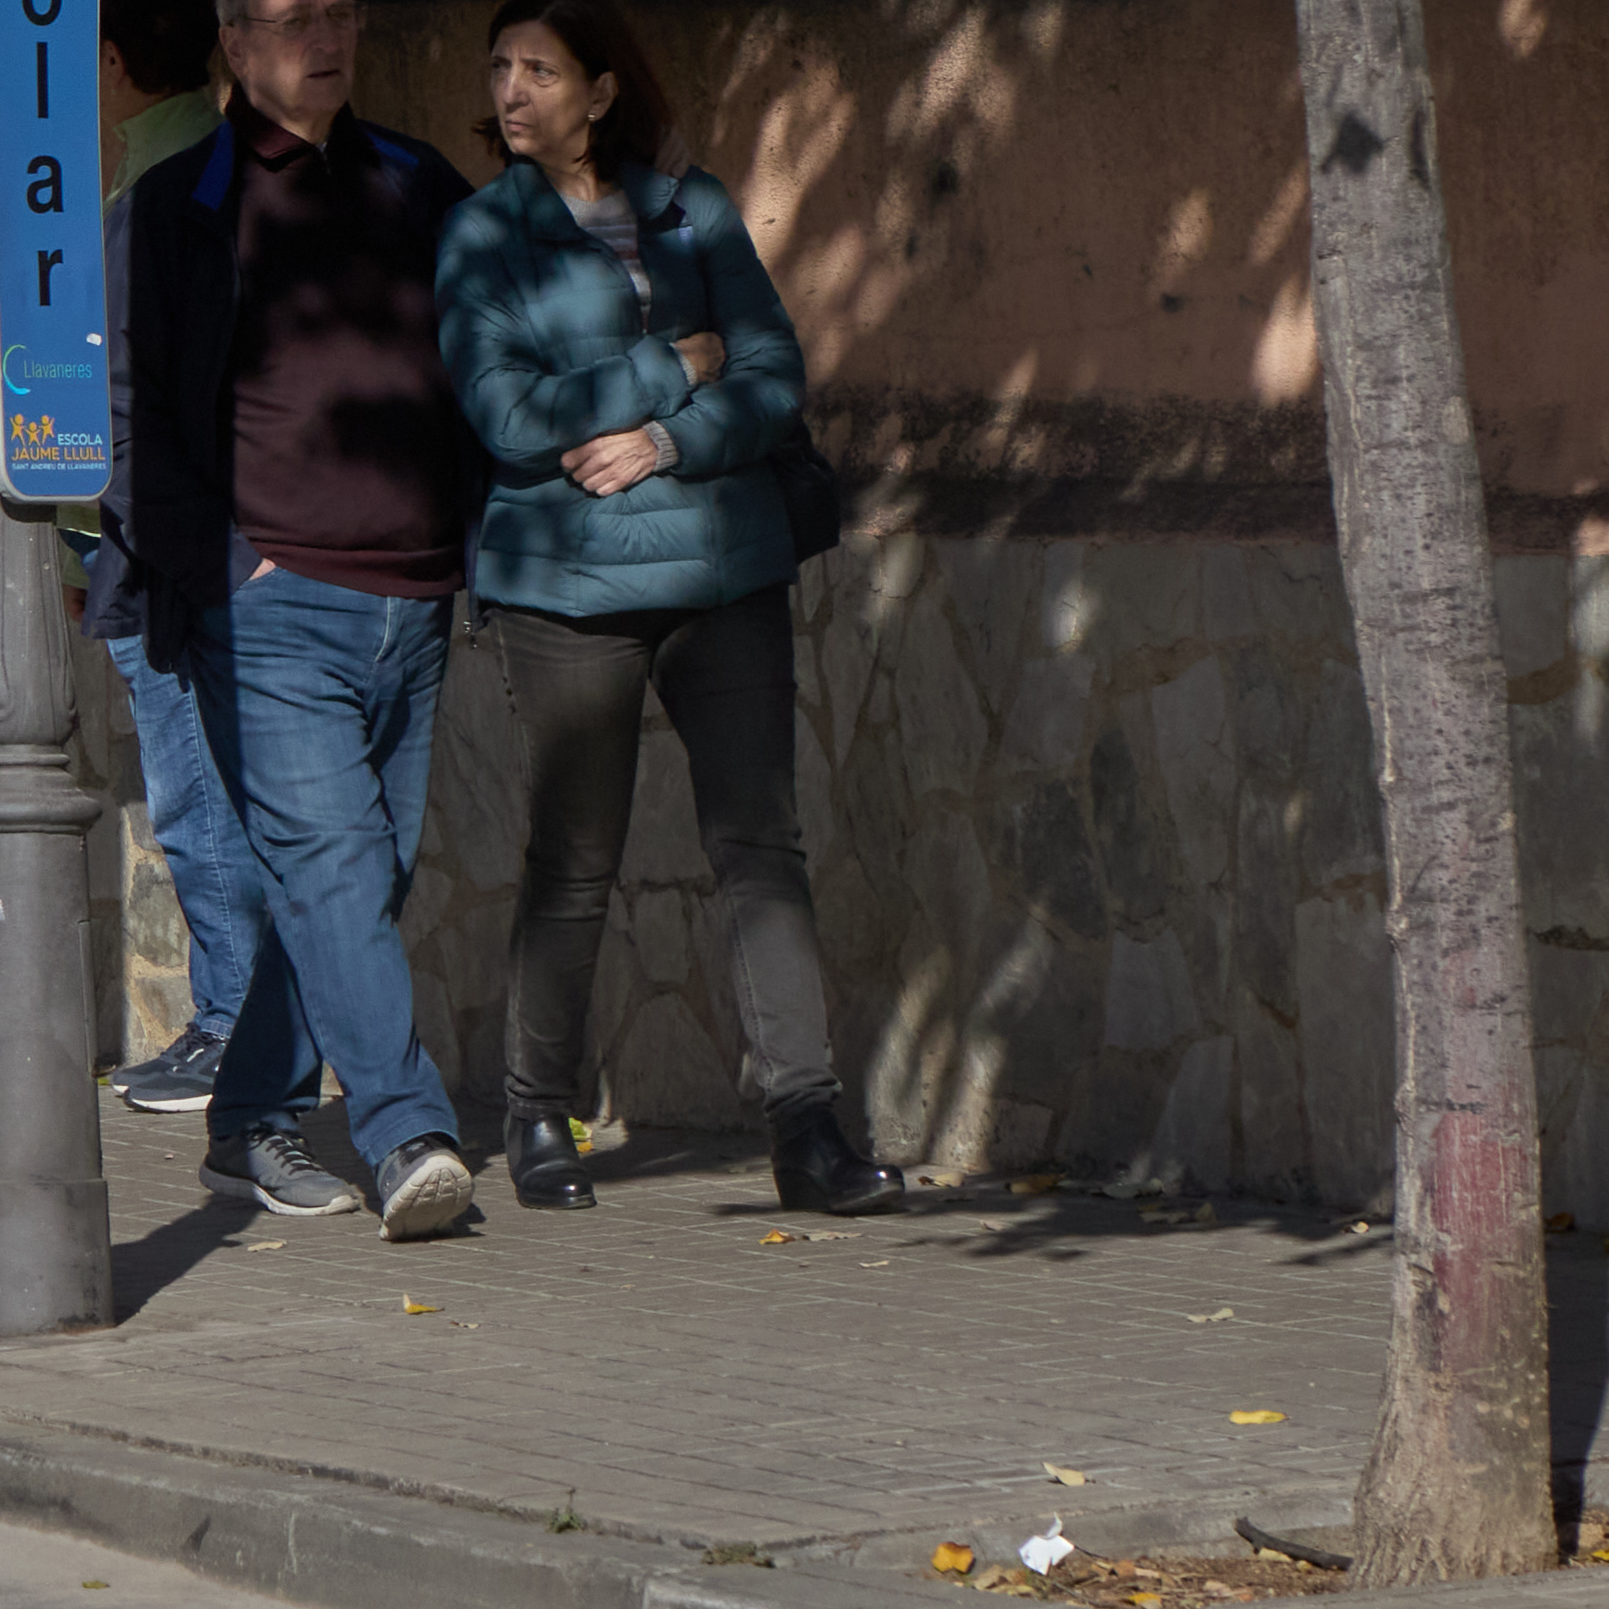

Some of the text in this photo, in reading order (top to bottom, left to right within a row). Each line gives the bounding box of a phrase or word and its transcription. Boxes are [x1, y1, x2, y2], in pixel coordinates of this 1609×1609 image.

[23, 359, 93, 379] Llavaneres
[57, 433, 103, 446] ESCOLA
[11, 446, 106, 461] JAUME LLULL
